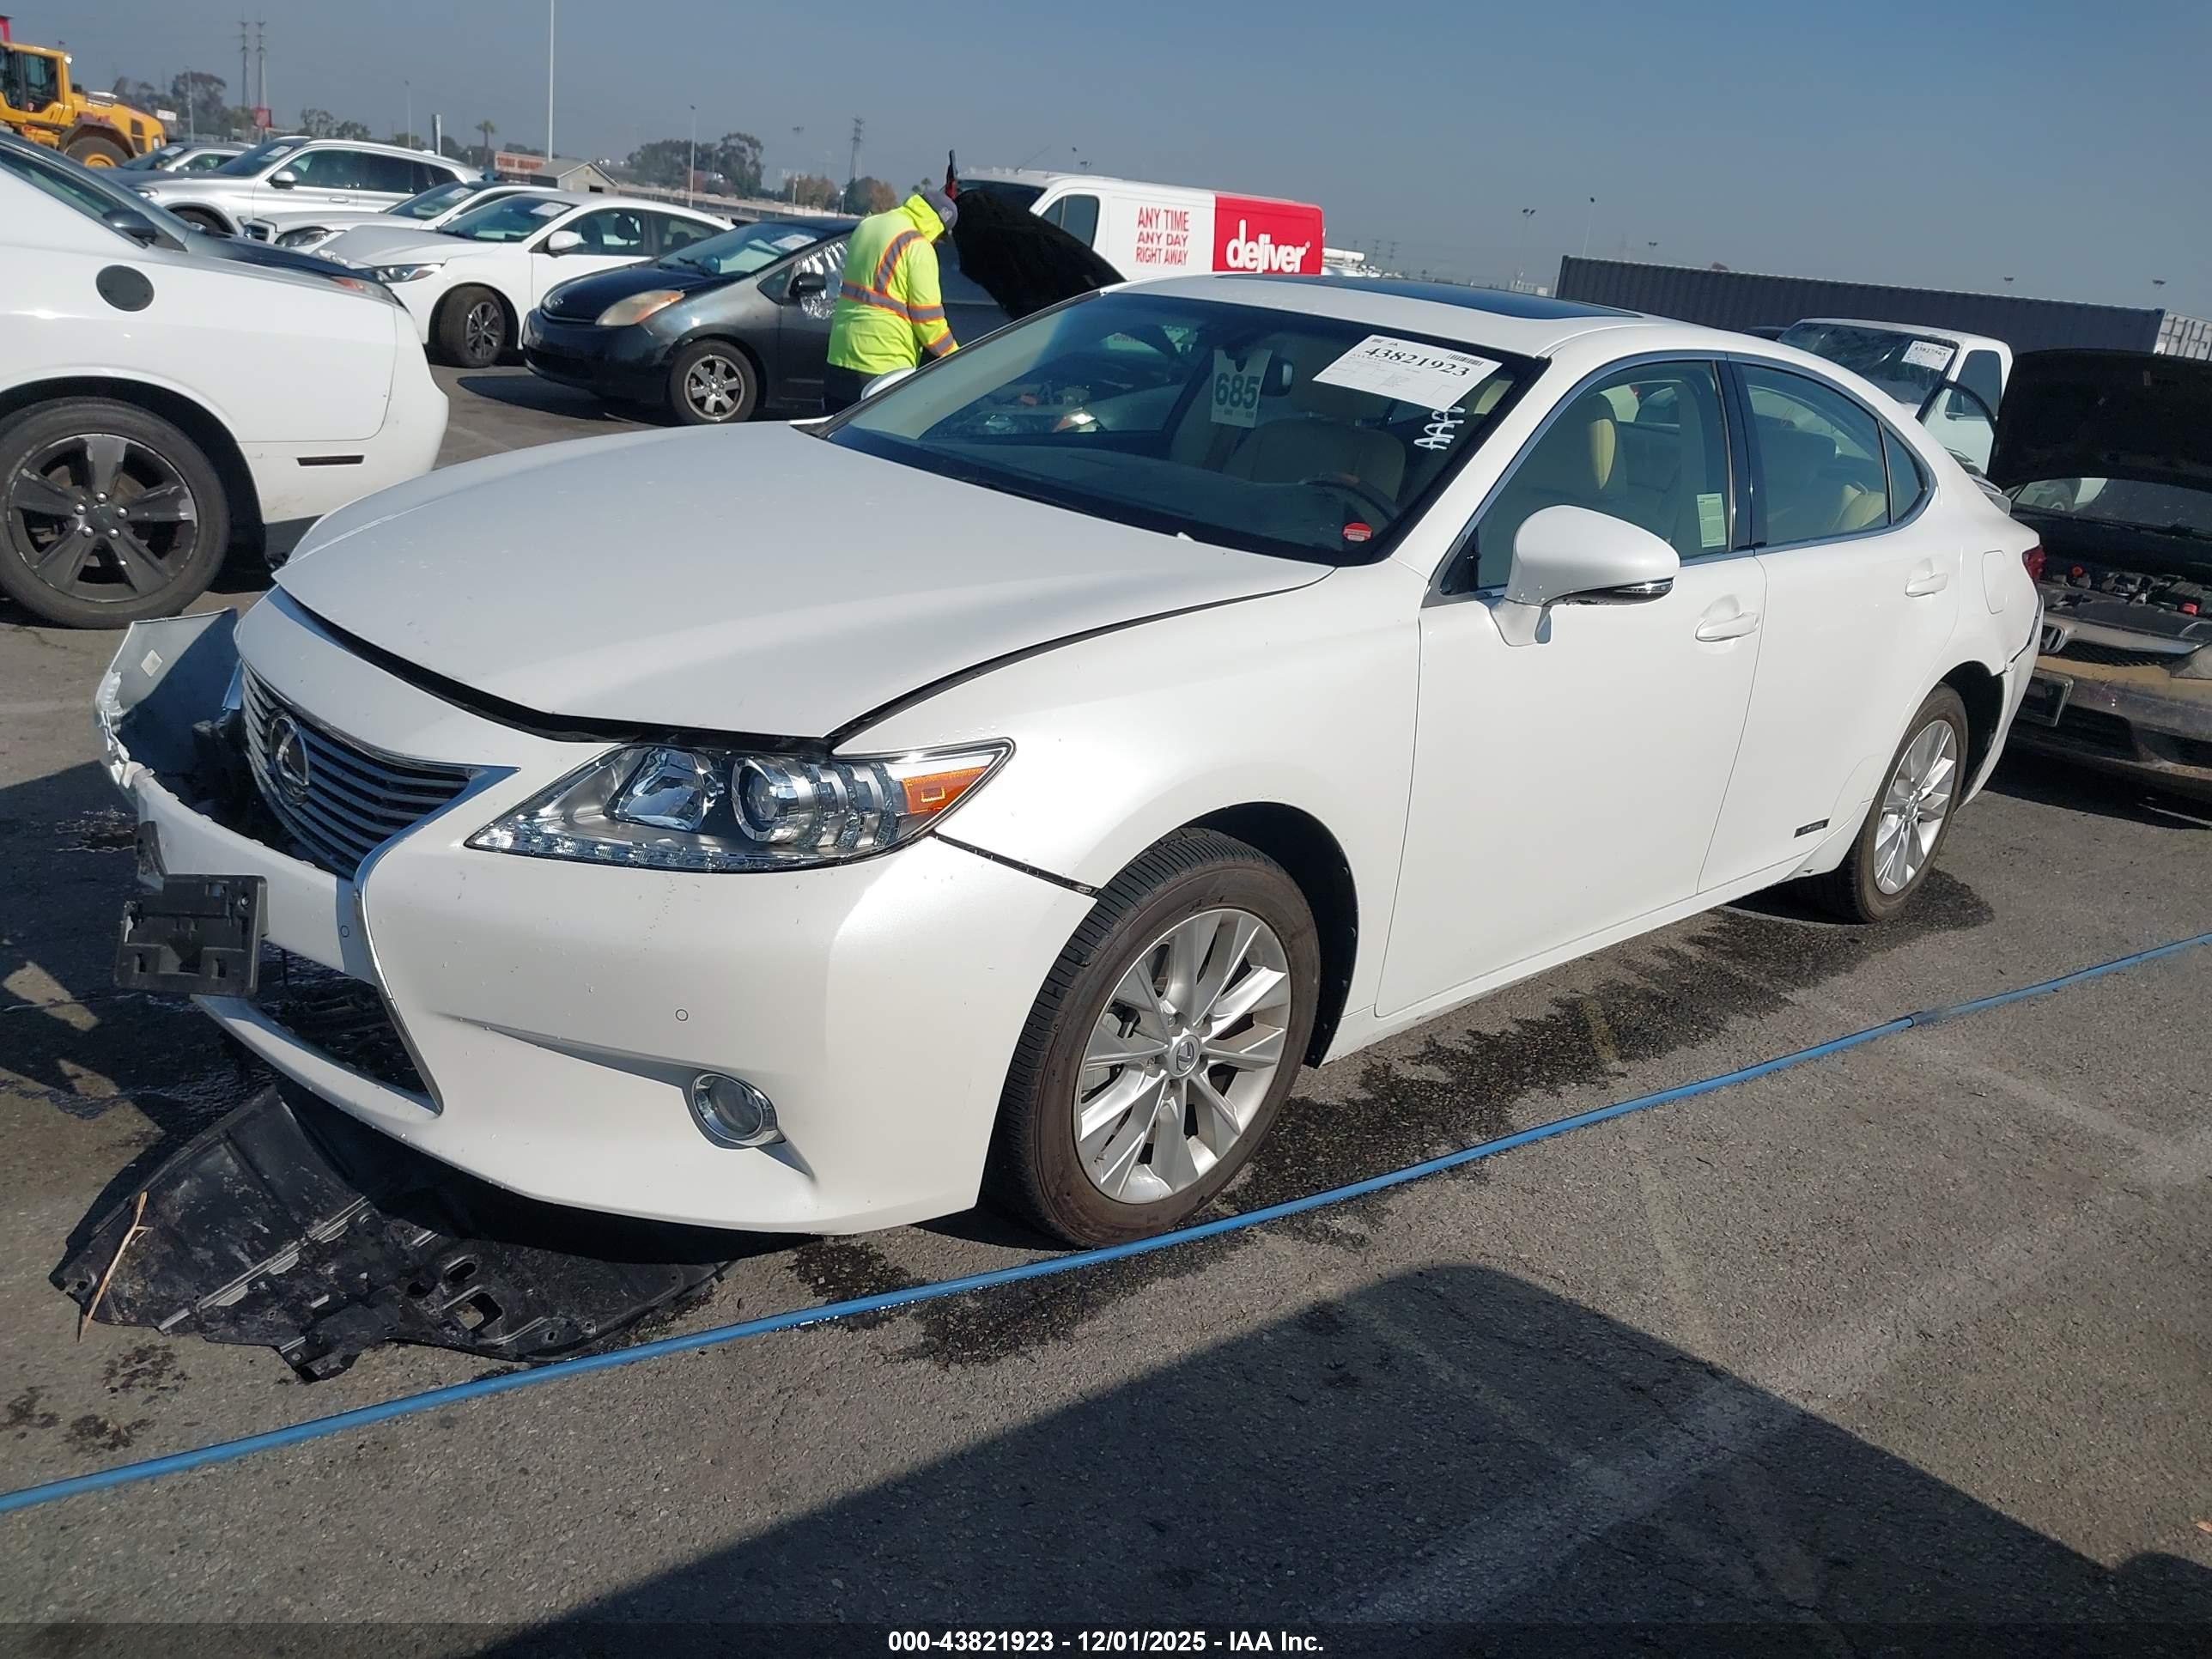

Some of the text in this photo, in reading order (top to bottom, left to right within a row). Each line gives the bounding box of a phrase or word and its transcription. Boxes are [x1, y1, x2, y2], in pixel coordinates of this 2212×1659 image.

[1138, 206, 1189, 232] ANY TIME
[1138, 231, 1188, 247] ANY DAY
[1136, 246, 1188, 266] RIGHT AWAY
[1364, 347, 1471, 378] 43821923
[1214, 372, 1261, 410] 685
